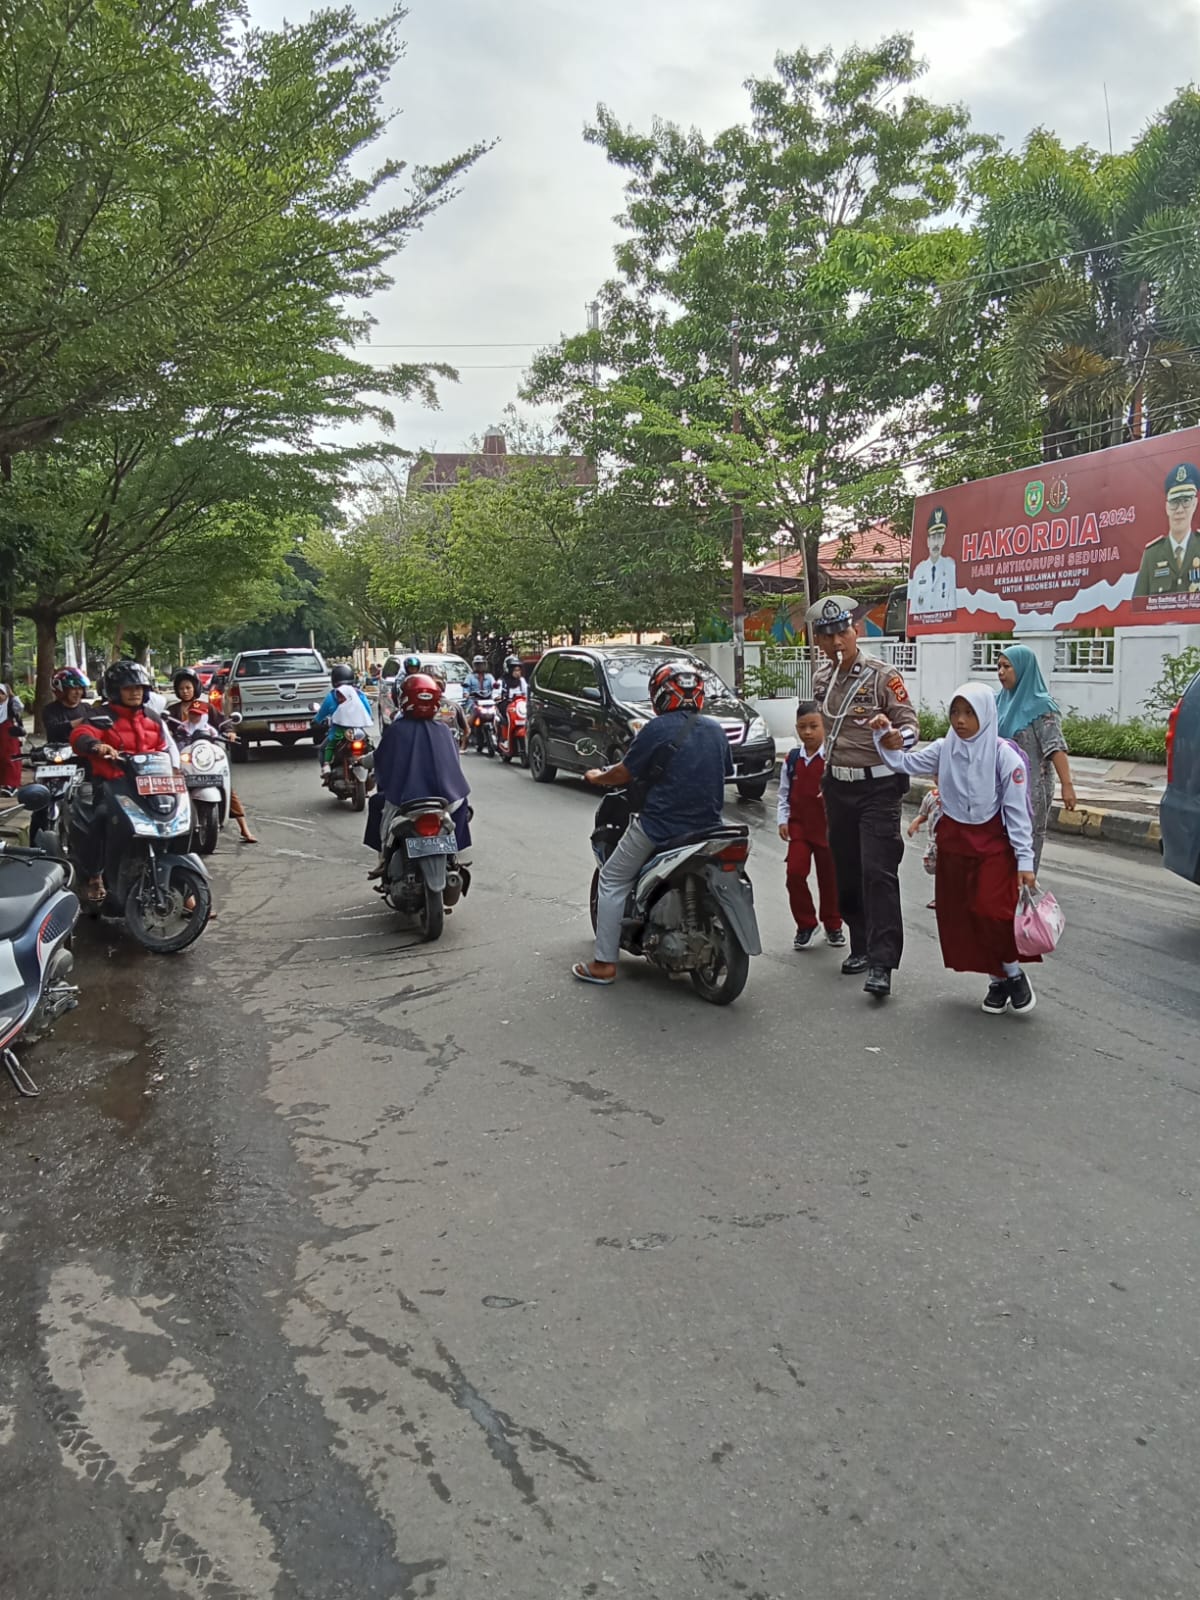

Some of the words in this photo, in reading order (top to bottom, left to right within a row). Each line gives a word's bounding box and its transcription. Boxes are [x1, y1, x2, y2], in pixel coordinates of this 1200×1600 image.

[962, 512, 1100, 562] HAKORDIA
[1099, 506, 1136, 528] 2024
[971, 565, 994, 578] HARI
[995, 554, 1065, 575] ANTIKORUPSI
[1067, 546, 1120, 567] SEDUNIA
[993, 576, 1023, 586] BERSAMA
[1024, 572, 1056, 583] MELAWAN
[1058, 567, 1090, 579] KORUPSI
[1002, 584, 1023, 594] UNTUK
[1024, 581, 1060, 592] INDONESIA
[1061, 579, 1081, 588] MAJU
[245, 703, 302, 712] RANG
